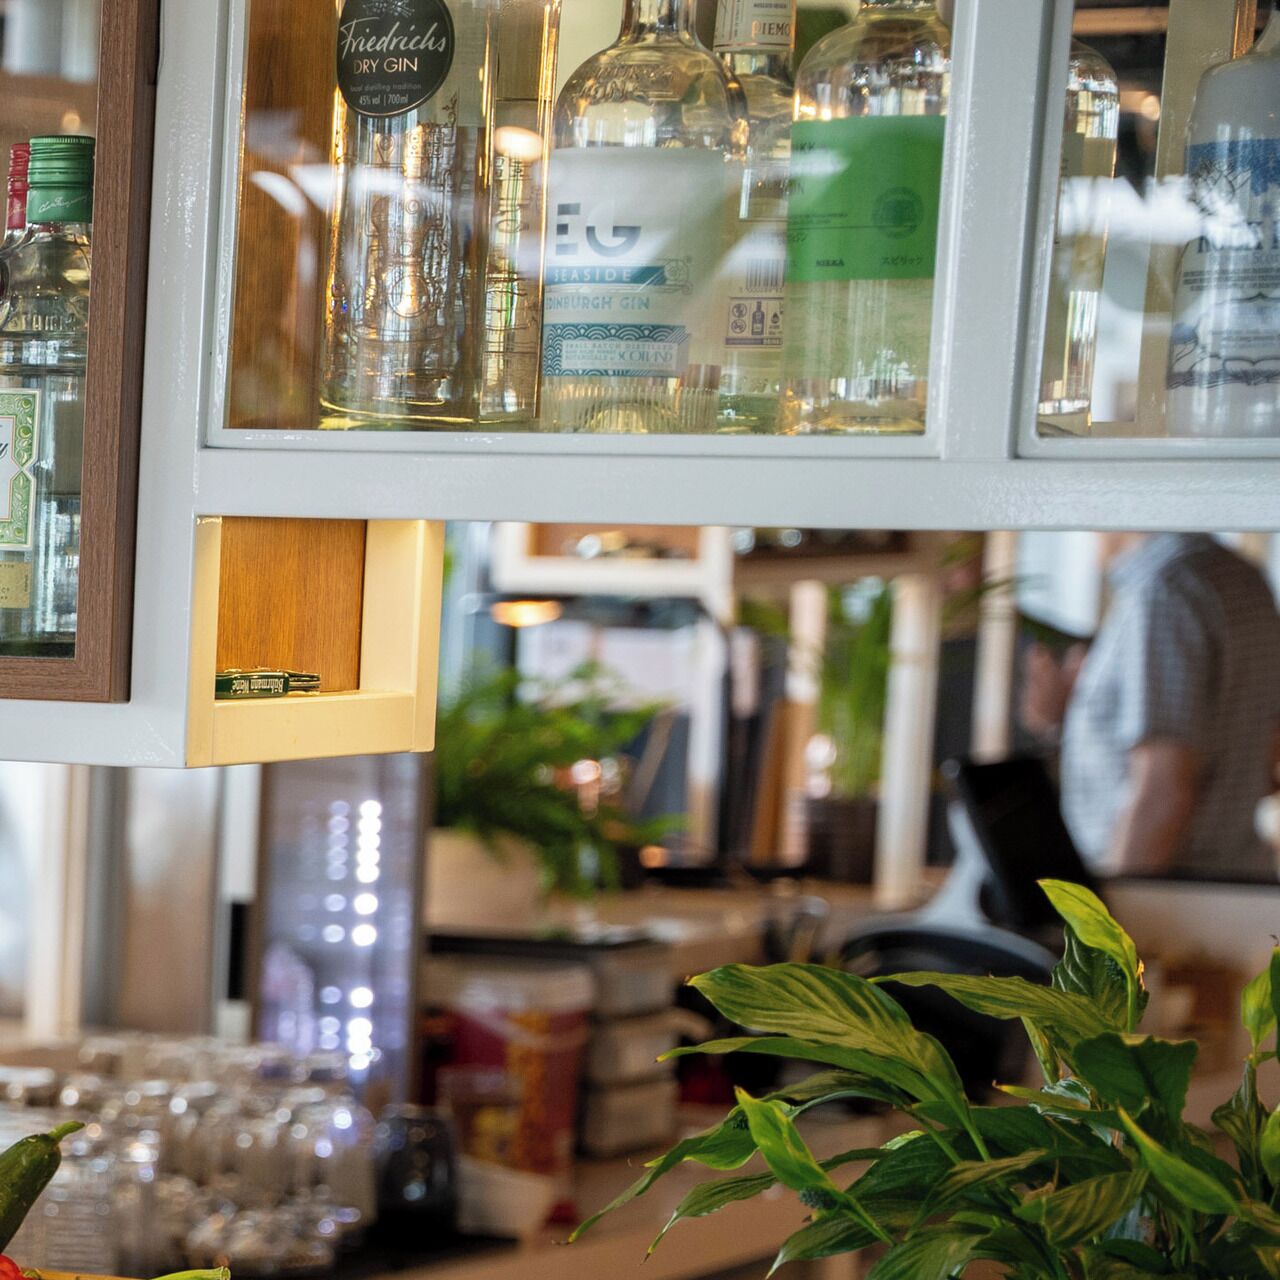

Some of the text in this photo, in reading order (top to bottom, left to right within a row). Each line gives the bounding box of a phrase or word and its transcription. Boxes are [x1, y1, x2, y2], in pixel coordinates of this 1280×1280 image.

[340, 17, 446, 60] Friedrichs
[353, 57, 418, 74] DRY GIN
[554, 268, 632, 282] SEASIDE
[619, 297, 651, 310] GIN
